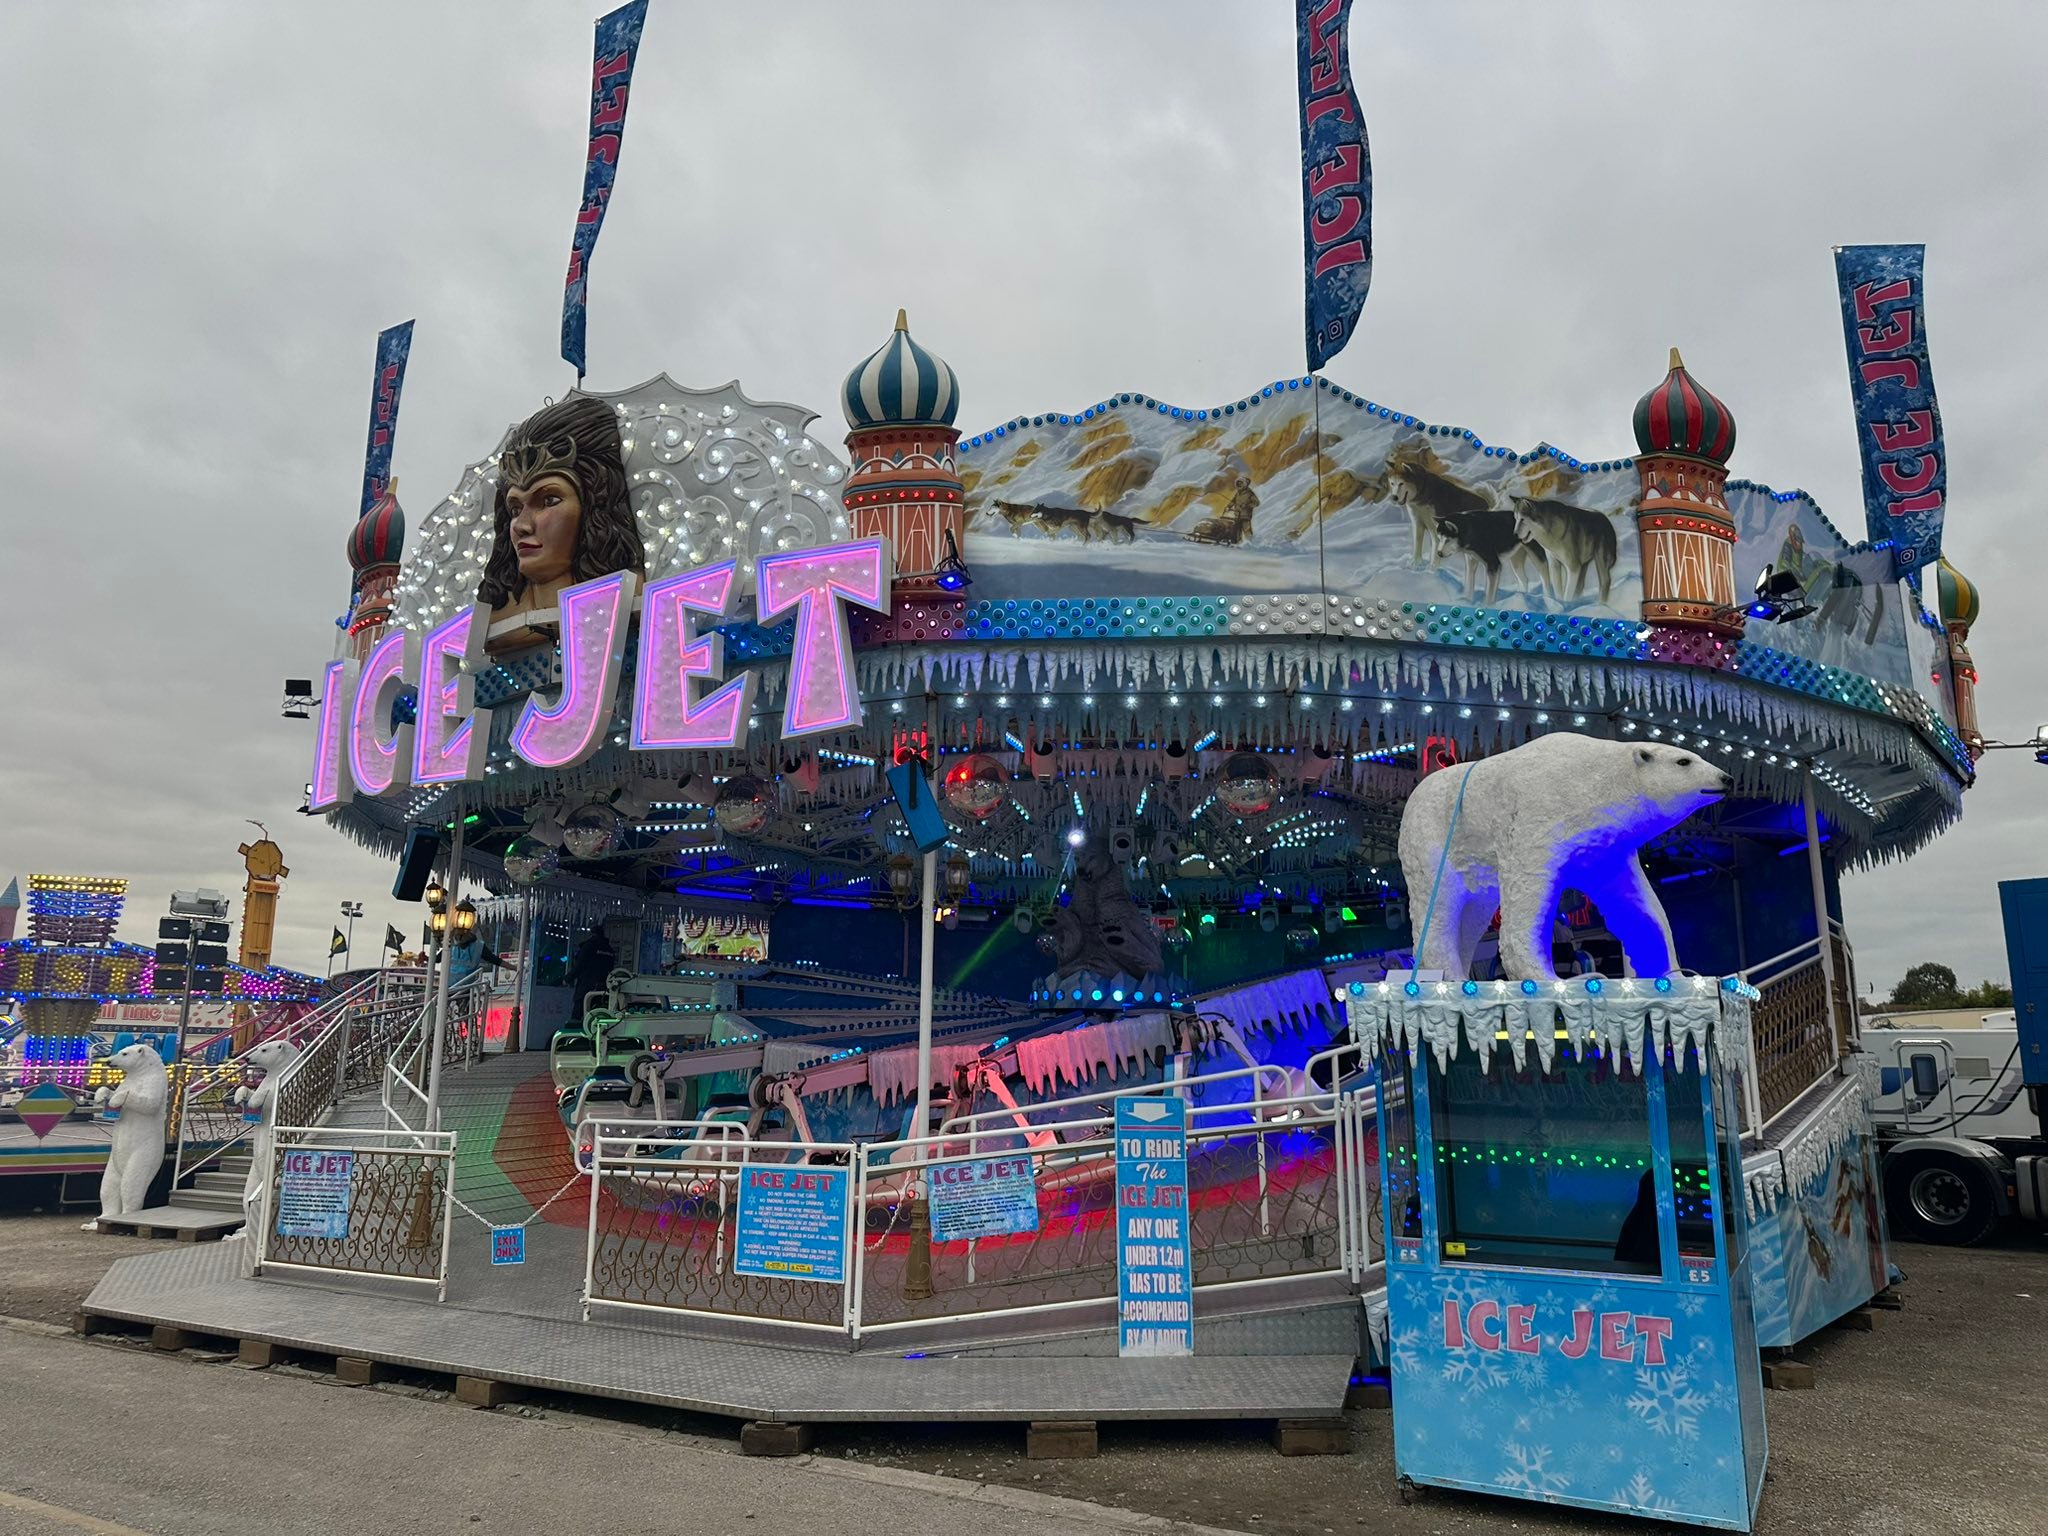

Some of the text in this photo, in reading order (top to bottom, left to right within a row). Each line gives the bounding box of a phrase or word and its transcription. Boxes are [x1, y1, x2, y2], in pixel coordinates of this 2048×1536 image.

[1310, 144, 1369, 279] ICE
[1853, 280, 1918, 390] JET
[1870, 410, 1942, 517] ICE
[309, 535, 891, 814] ICE JET
[0, 953, 140, 993] IST
[1121, 1139, 1181, 1158] TO RIDE
[285, 1154, 351, 1175] ICE JET
[933, 1159, 1029, 1185] ICE JET
[1136, 1162, 1168, 1183] The
[750, 1171, 835, 1192] ICE JET
[1120, 1185, 1184, 1208] ICE JET
[1128, 1218, 1179, 1239] ANY ONE
[497, 1236, 518, 1246] EXIT
[495, 1247, 520, 1258] ONLY
[1125, 1245, 1184, 1266] UNDER 1.2m
[1129, 1273, 1182, 1294] HAS TO BE
[1688, 1269, 1710, 1282] £5
[1123, 1301, 1189, 1322] ACCOMPANIED
[1126, 1329, 1140, 1348] BY
[1141, 1329, 1156, 1348] AN
[1442, 1299, 1672, 1366] ICE JET
